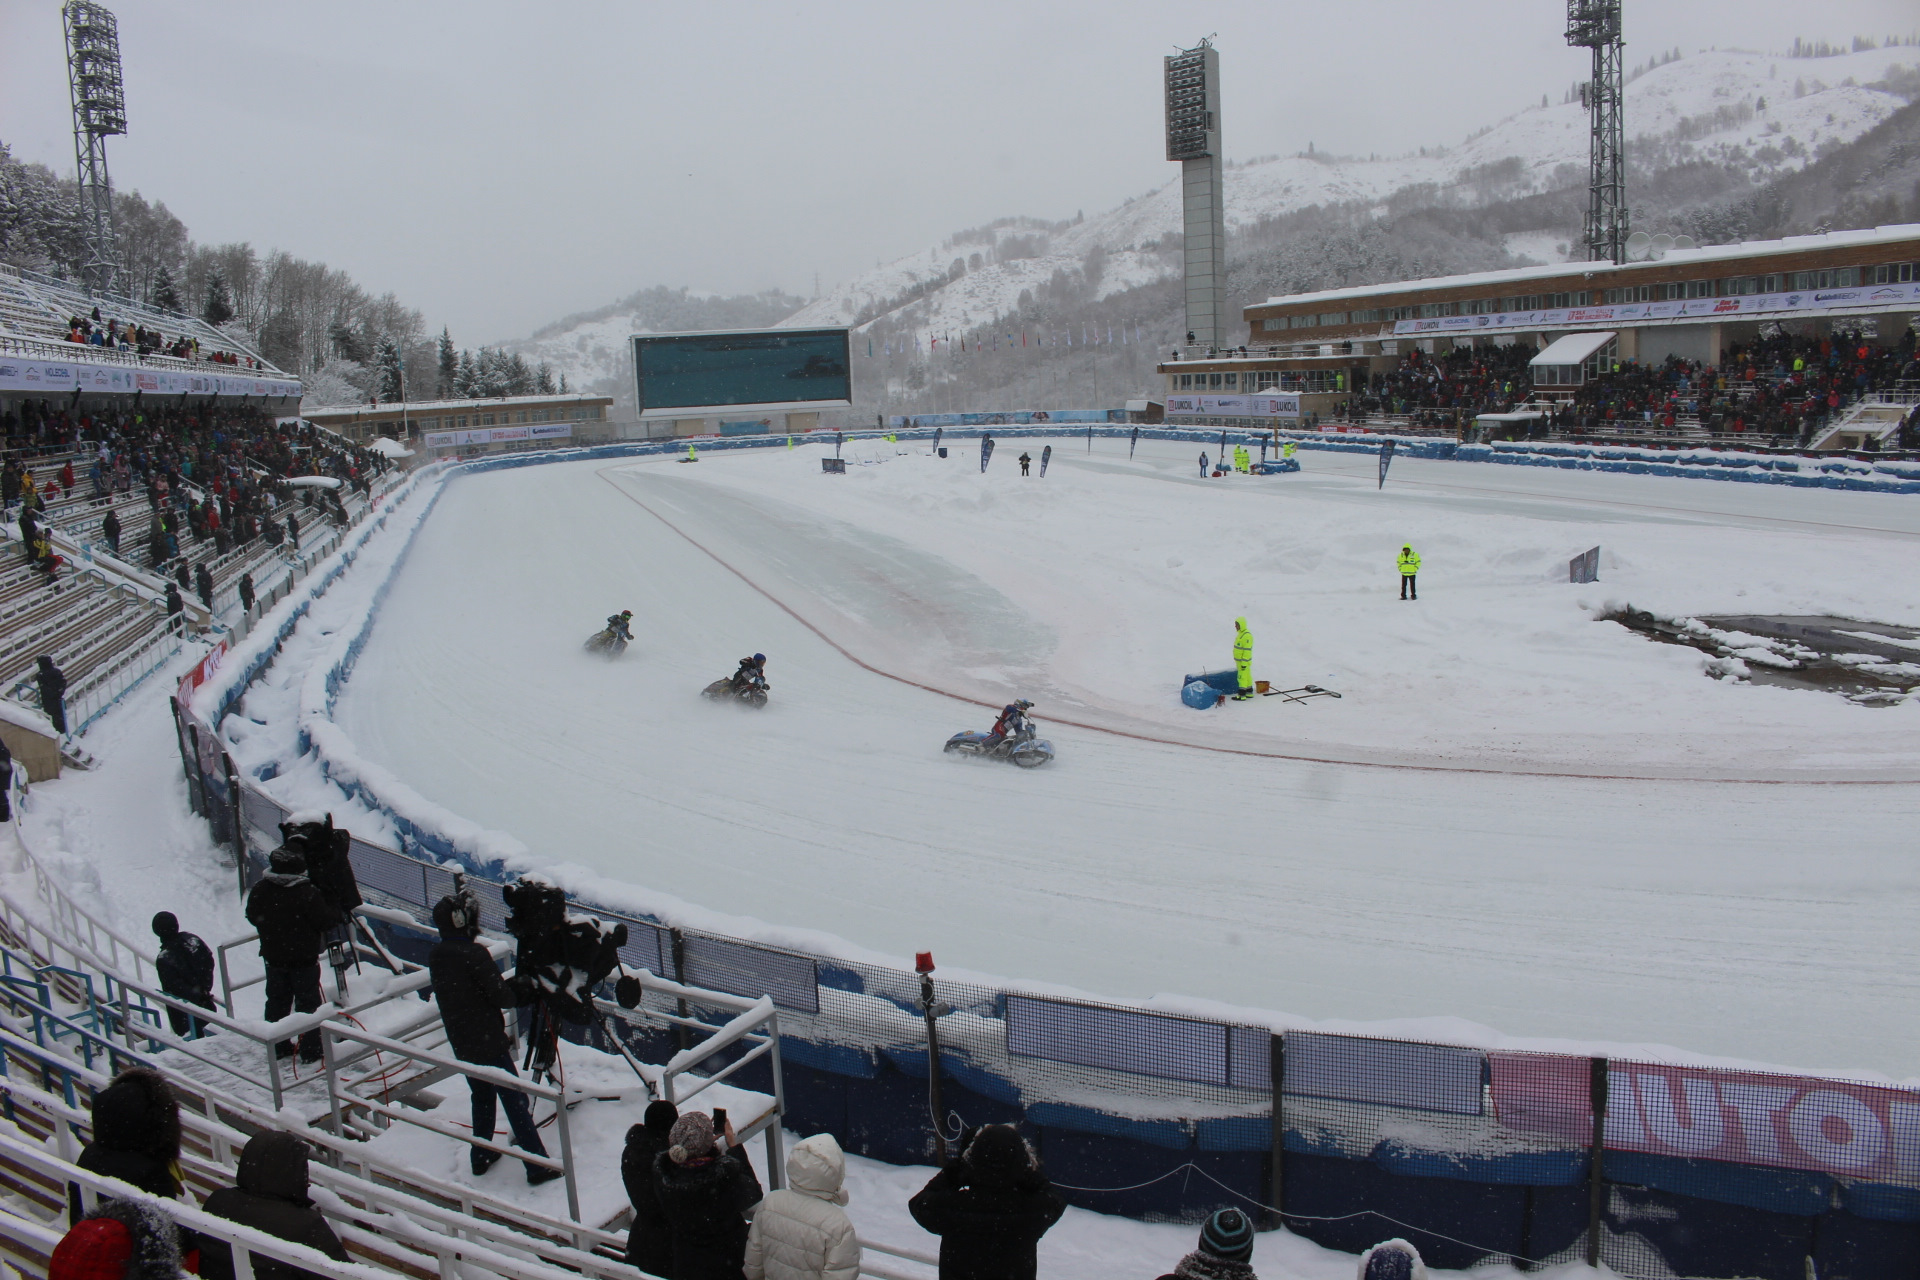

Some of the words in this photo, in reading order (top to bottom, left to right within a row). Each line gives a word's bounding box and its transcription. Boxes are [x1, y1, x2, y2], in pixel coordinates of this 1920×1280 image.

[1421, 321, 1440, 329] LUKOIL
[1174, 400, 1193, 410] LUKOIL
[1276, 400, 1298, 412] LUKOIL
[434, 436, 453, 445] LUKOIL
